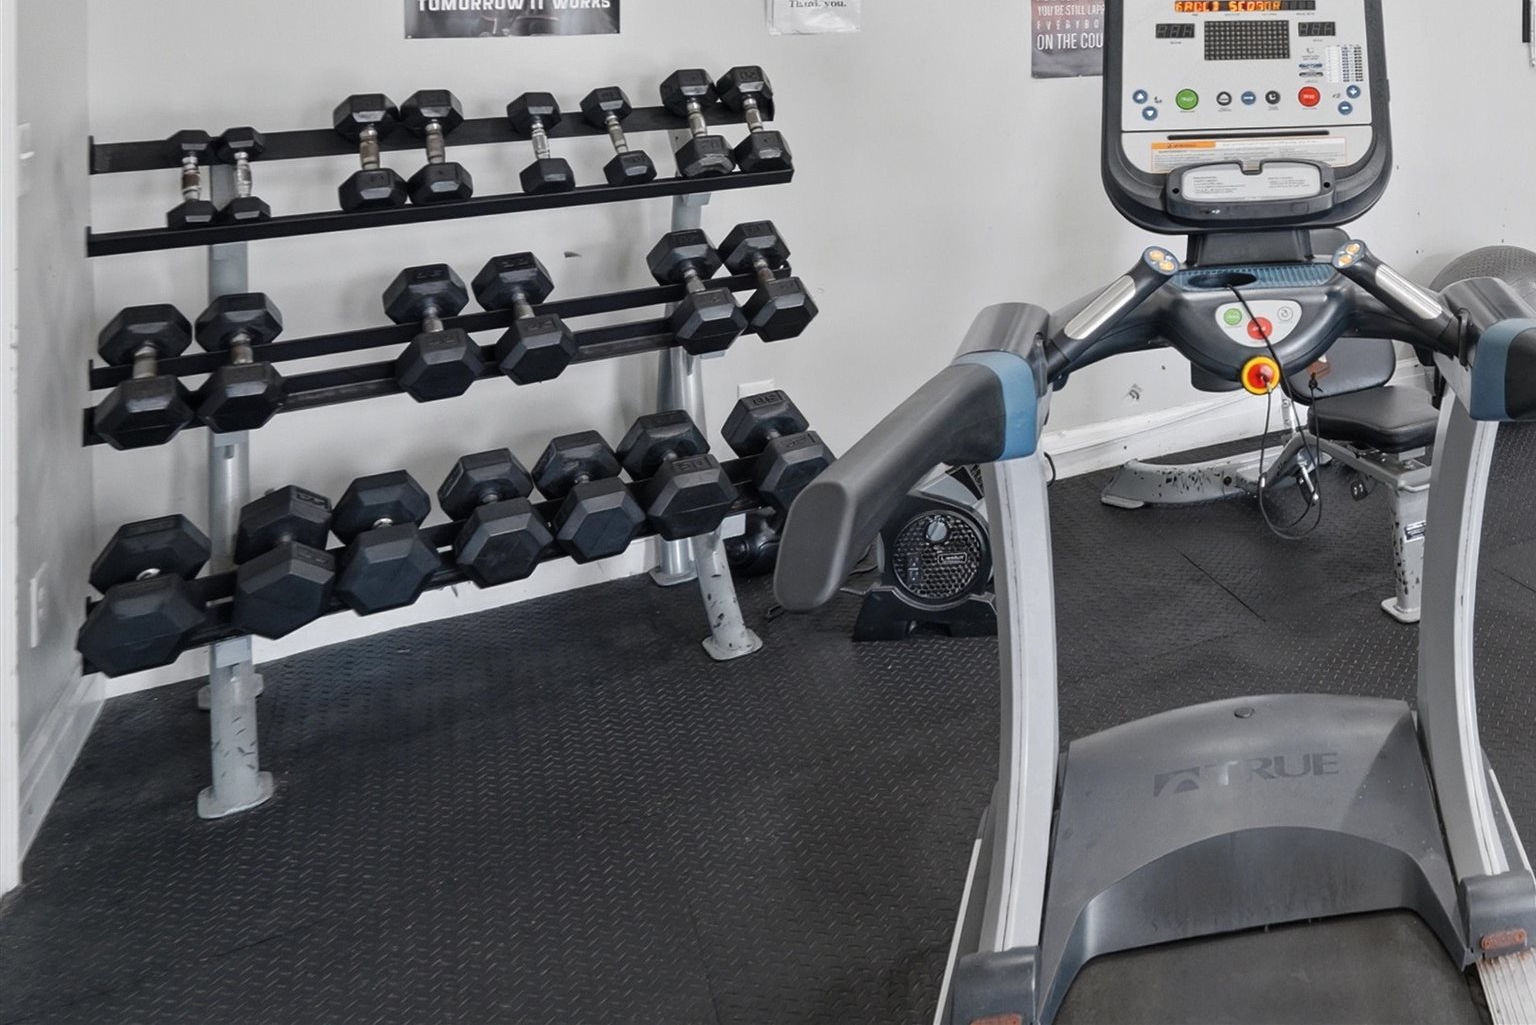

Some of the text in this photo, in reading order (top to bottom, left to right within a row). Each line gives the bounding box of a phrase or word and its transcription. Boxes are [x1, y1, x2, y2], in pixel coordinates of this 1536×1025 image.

[1065, 4, 1085, 16] STILL
[1037, 32, 1104, 50] ON THE COU
[1204, 752, 1340, 786] TRUE
